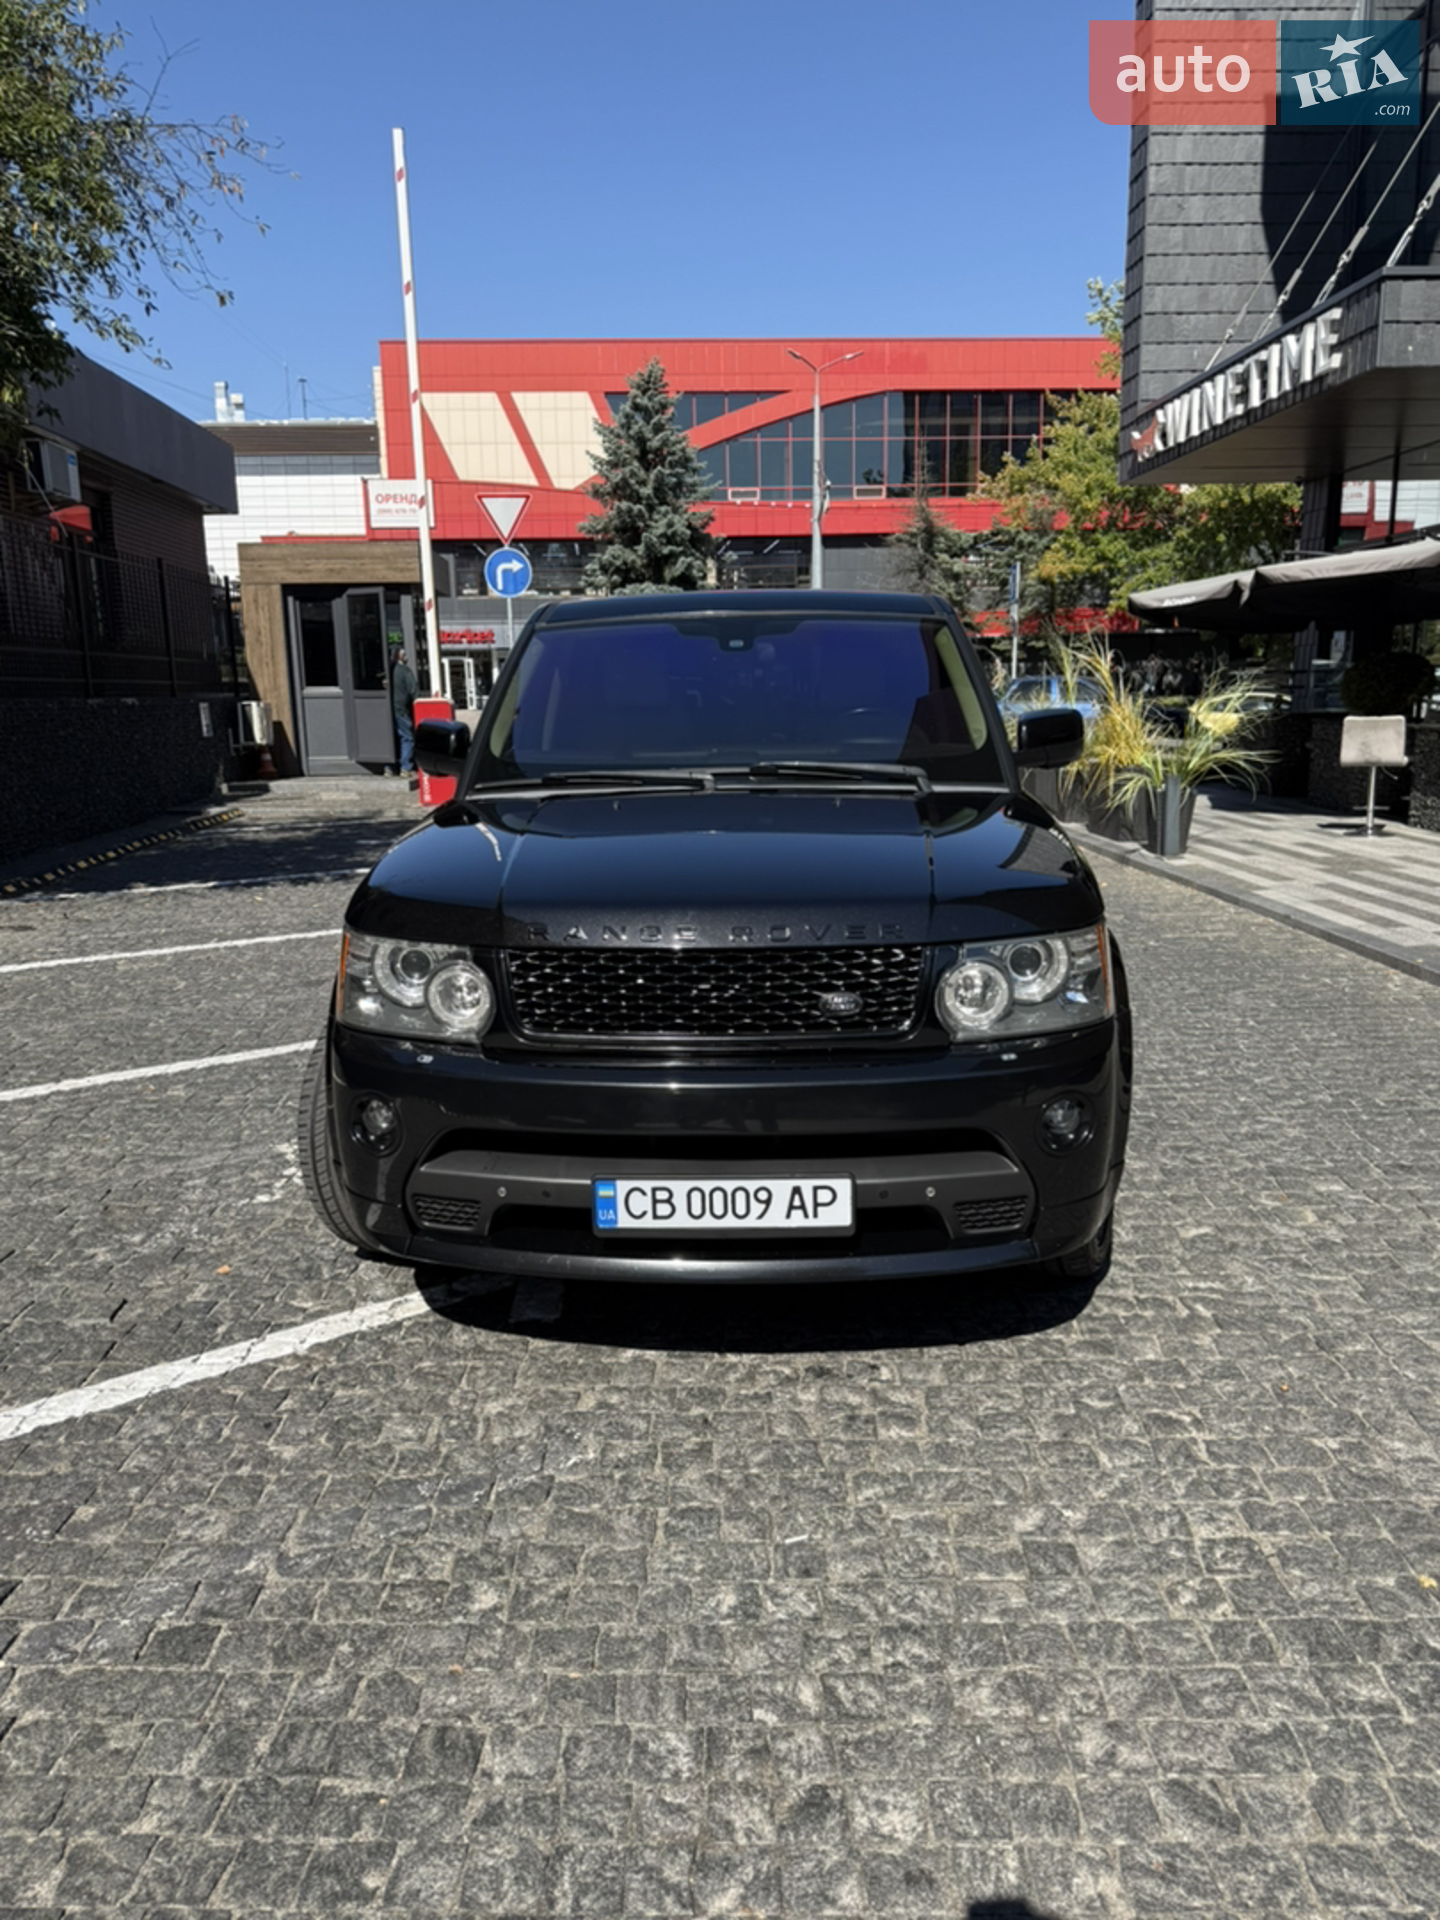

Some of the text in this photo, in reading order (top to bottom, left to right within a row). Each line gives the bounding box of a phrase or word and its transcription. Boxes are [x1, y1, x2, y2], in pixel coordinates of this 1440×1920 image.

[1163, 307, 1344, 448] WINETIME
[375, 493, 418, 505] ОРЕНД
[527, 923, 905, 943] RANGE ROVER
[623, 1185, 838, 1220] CB 0009 AP
[598, 1209, 616, 1221] UA
